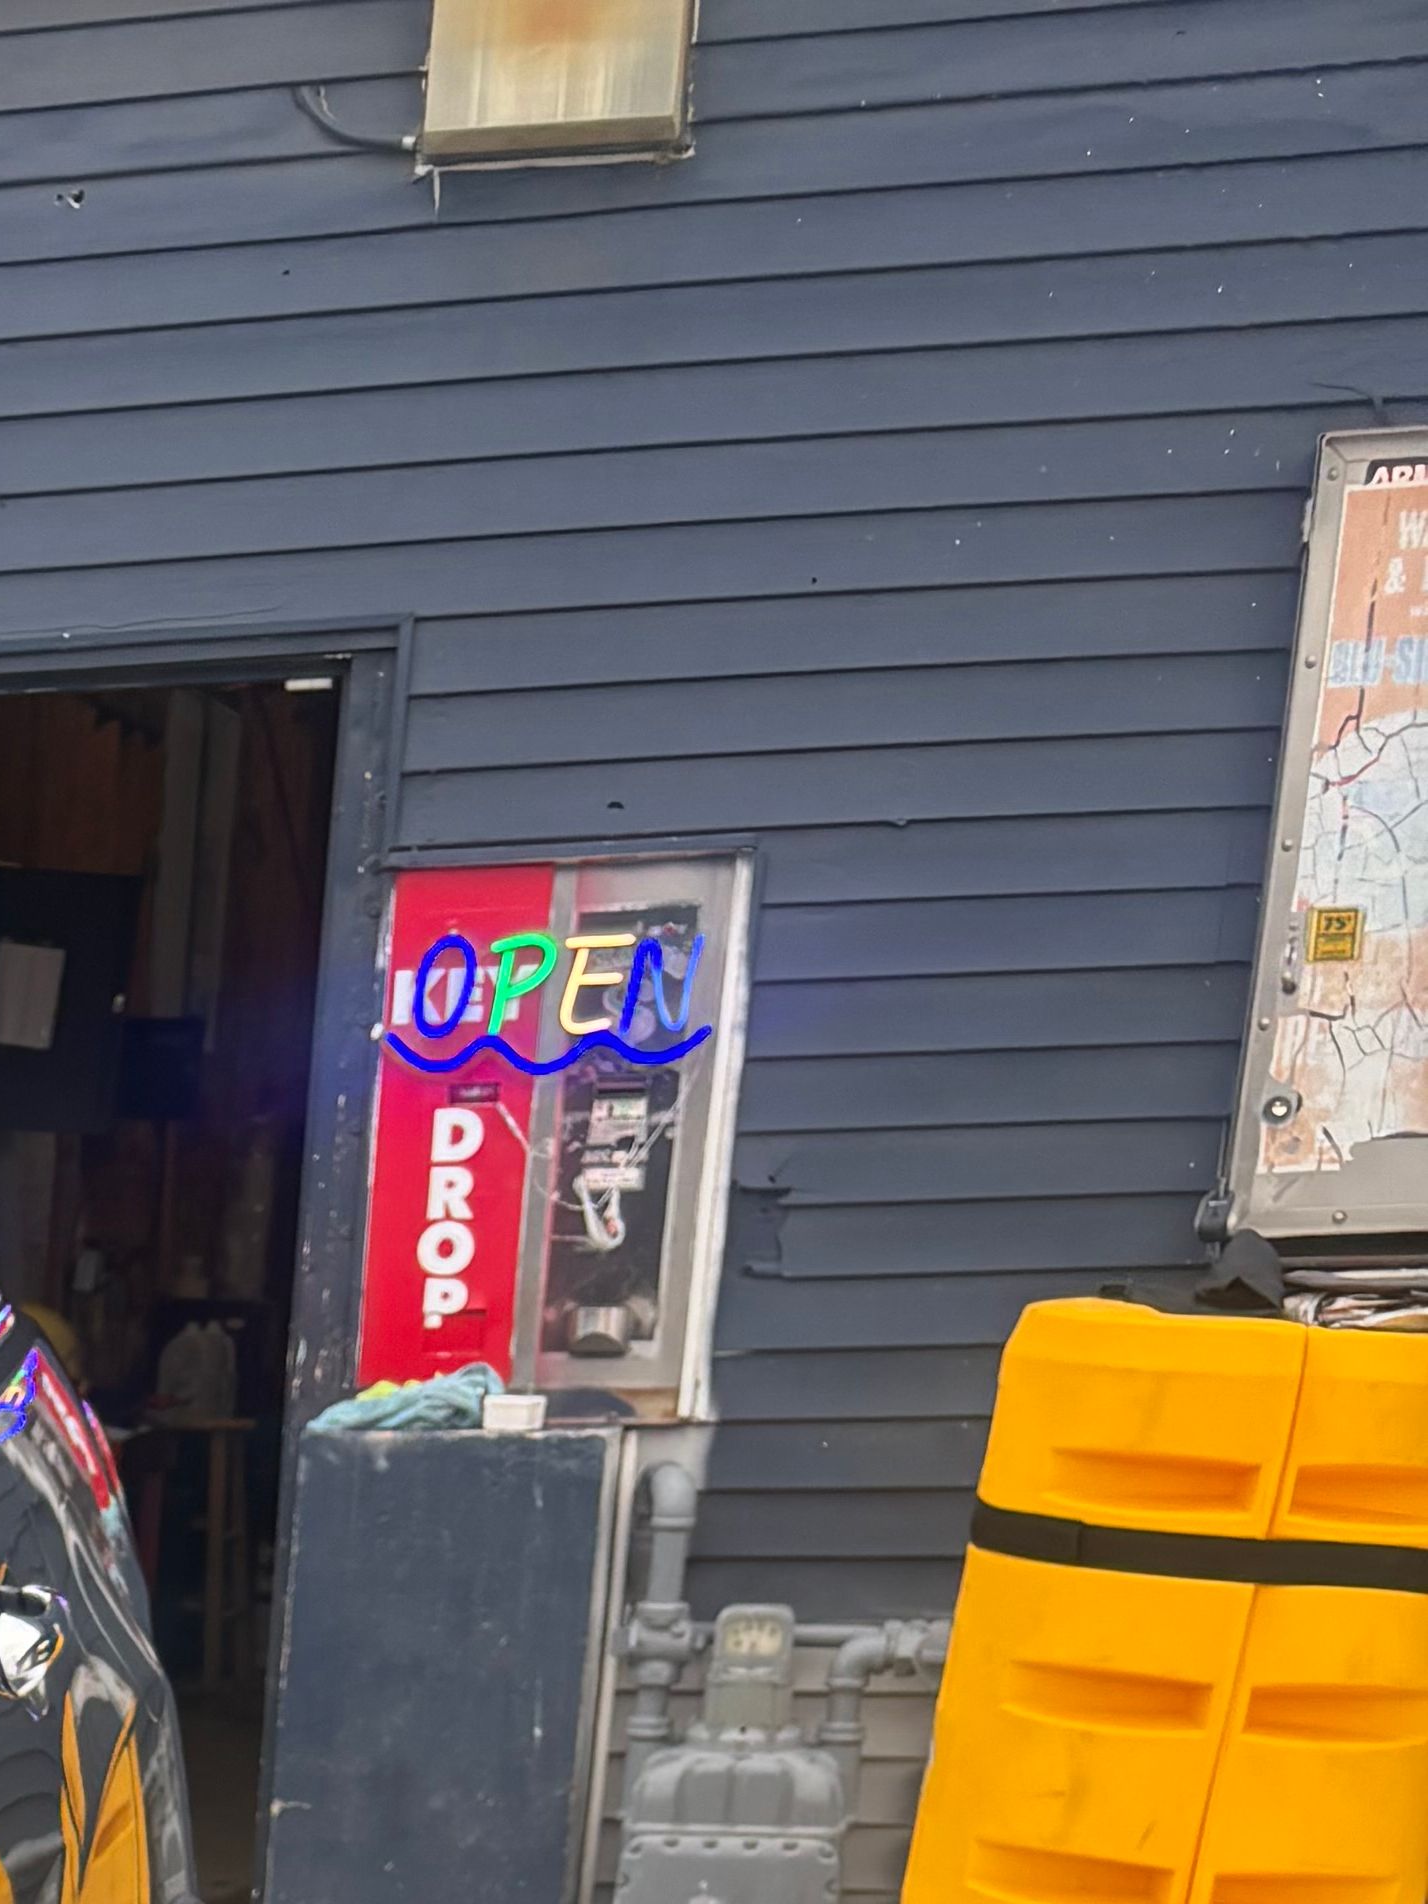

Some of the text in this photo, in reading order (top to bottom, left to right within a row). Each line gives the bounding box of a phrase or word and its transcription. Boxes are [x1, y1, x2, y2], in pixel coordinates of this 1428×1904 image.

[391, 963, 542, 1025] KEY
[414, 932, 705, 1038] OPEN
[416, 1107, 485, 1329] DROP
